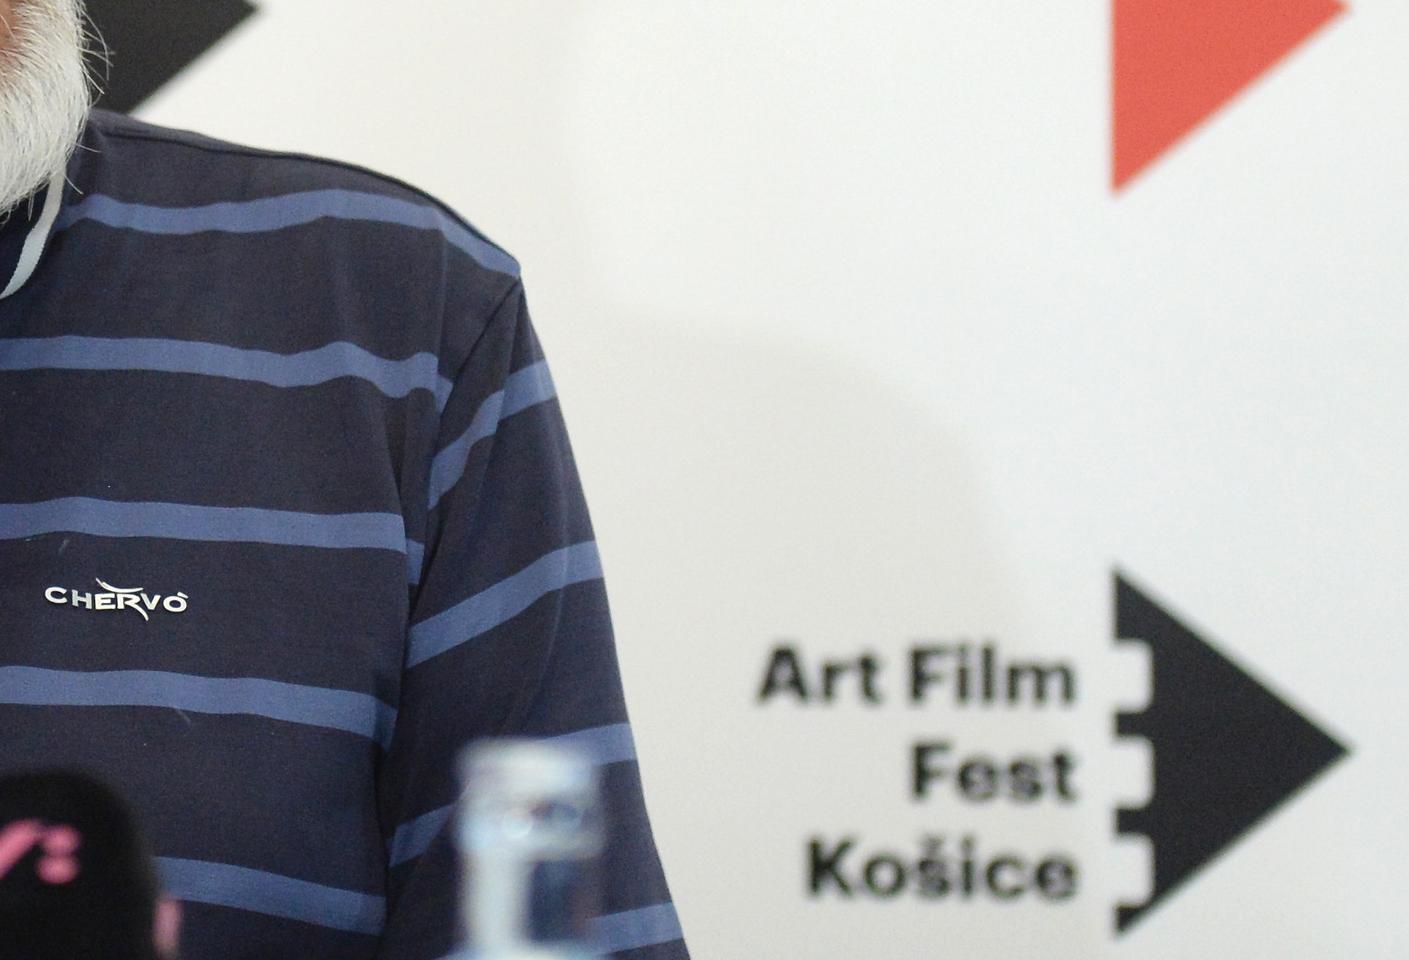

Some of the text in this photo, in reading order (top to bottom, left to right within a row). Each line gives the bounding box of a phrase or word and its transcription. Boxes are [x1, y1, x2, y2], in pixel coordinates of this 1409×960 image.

[757, 643, 1077, 705] Art Film
[910, 740, 1075, 803] Fest
[804, 837, 1079, 902] Košice
